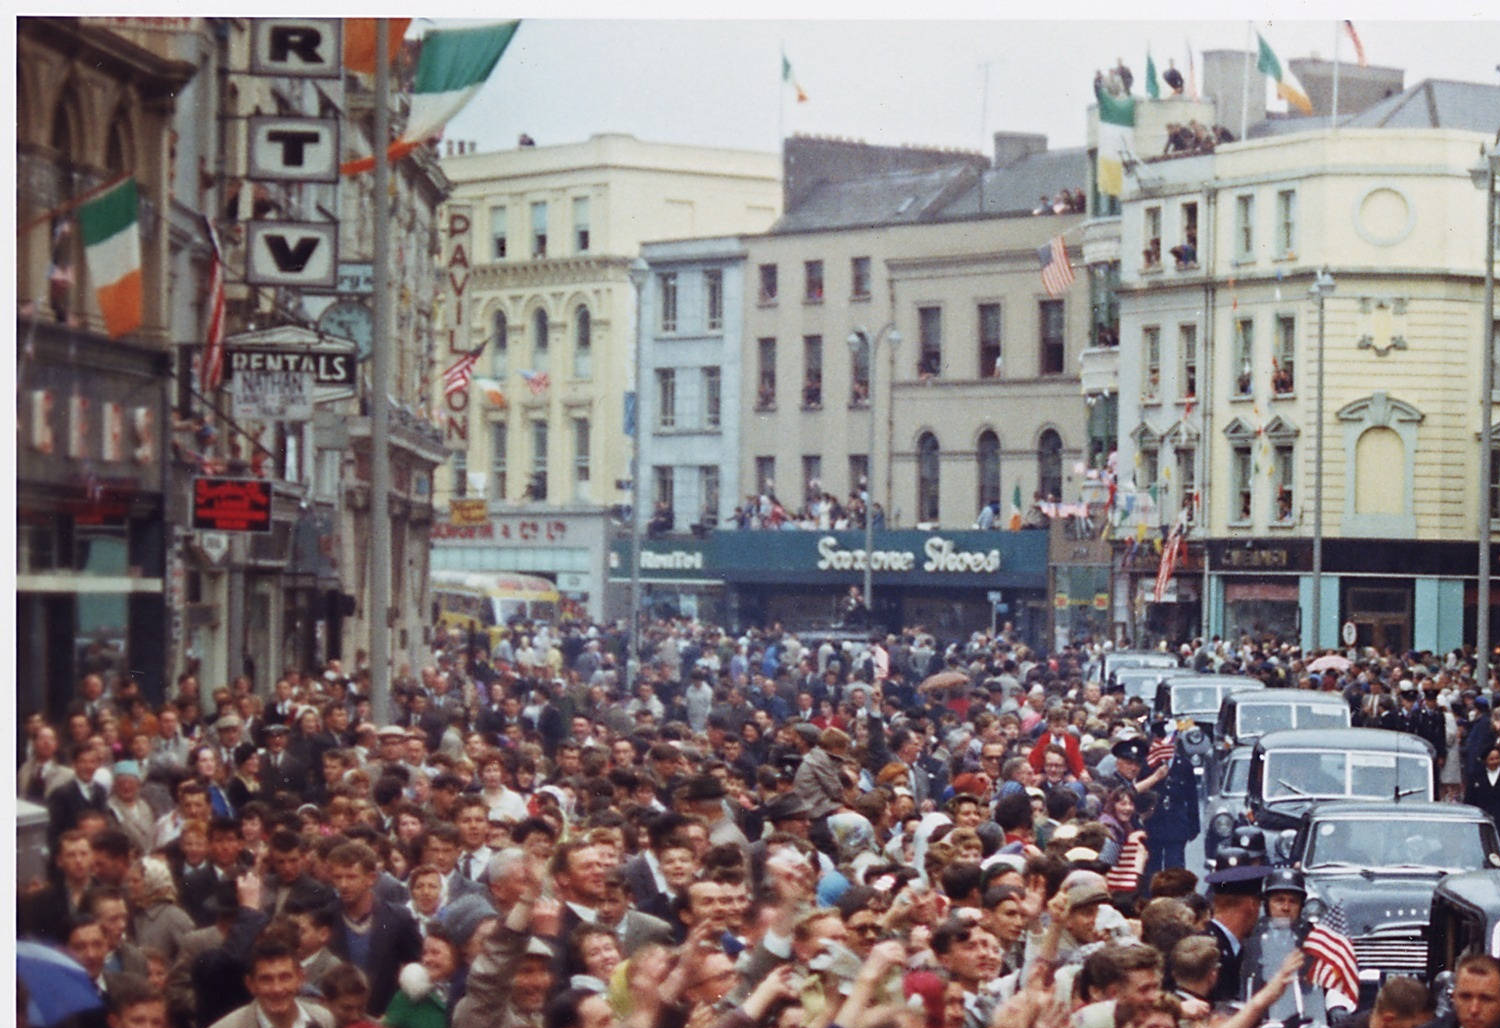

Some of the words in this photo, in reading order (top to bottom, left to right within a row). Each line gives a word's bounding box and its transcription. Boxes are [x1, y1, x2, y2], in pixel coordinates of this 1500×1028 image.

[447, 214, 470, 440] PAVILON
[232, 353, 347, 380] RENTALS
[817, 536, 915, 572] Saxone
[923, 536, 1000, 573] Shoes
